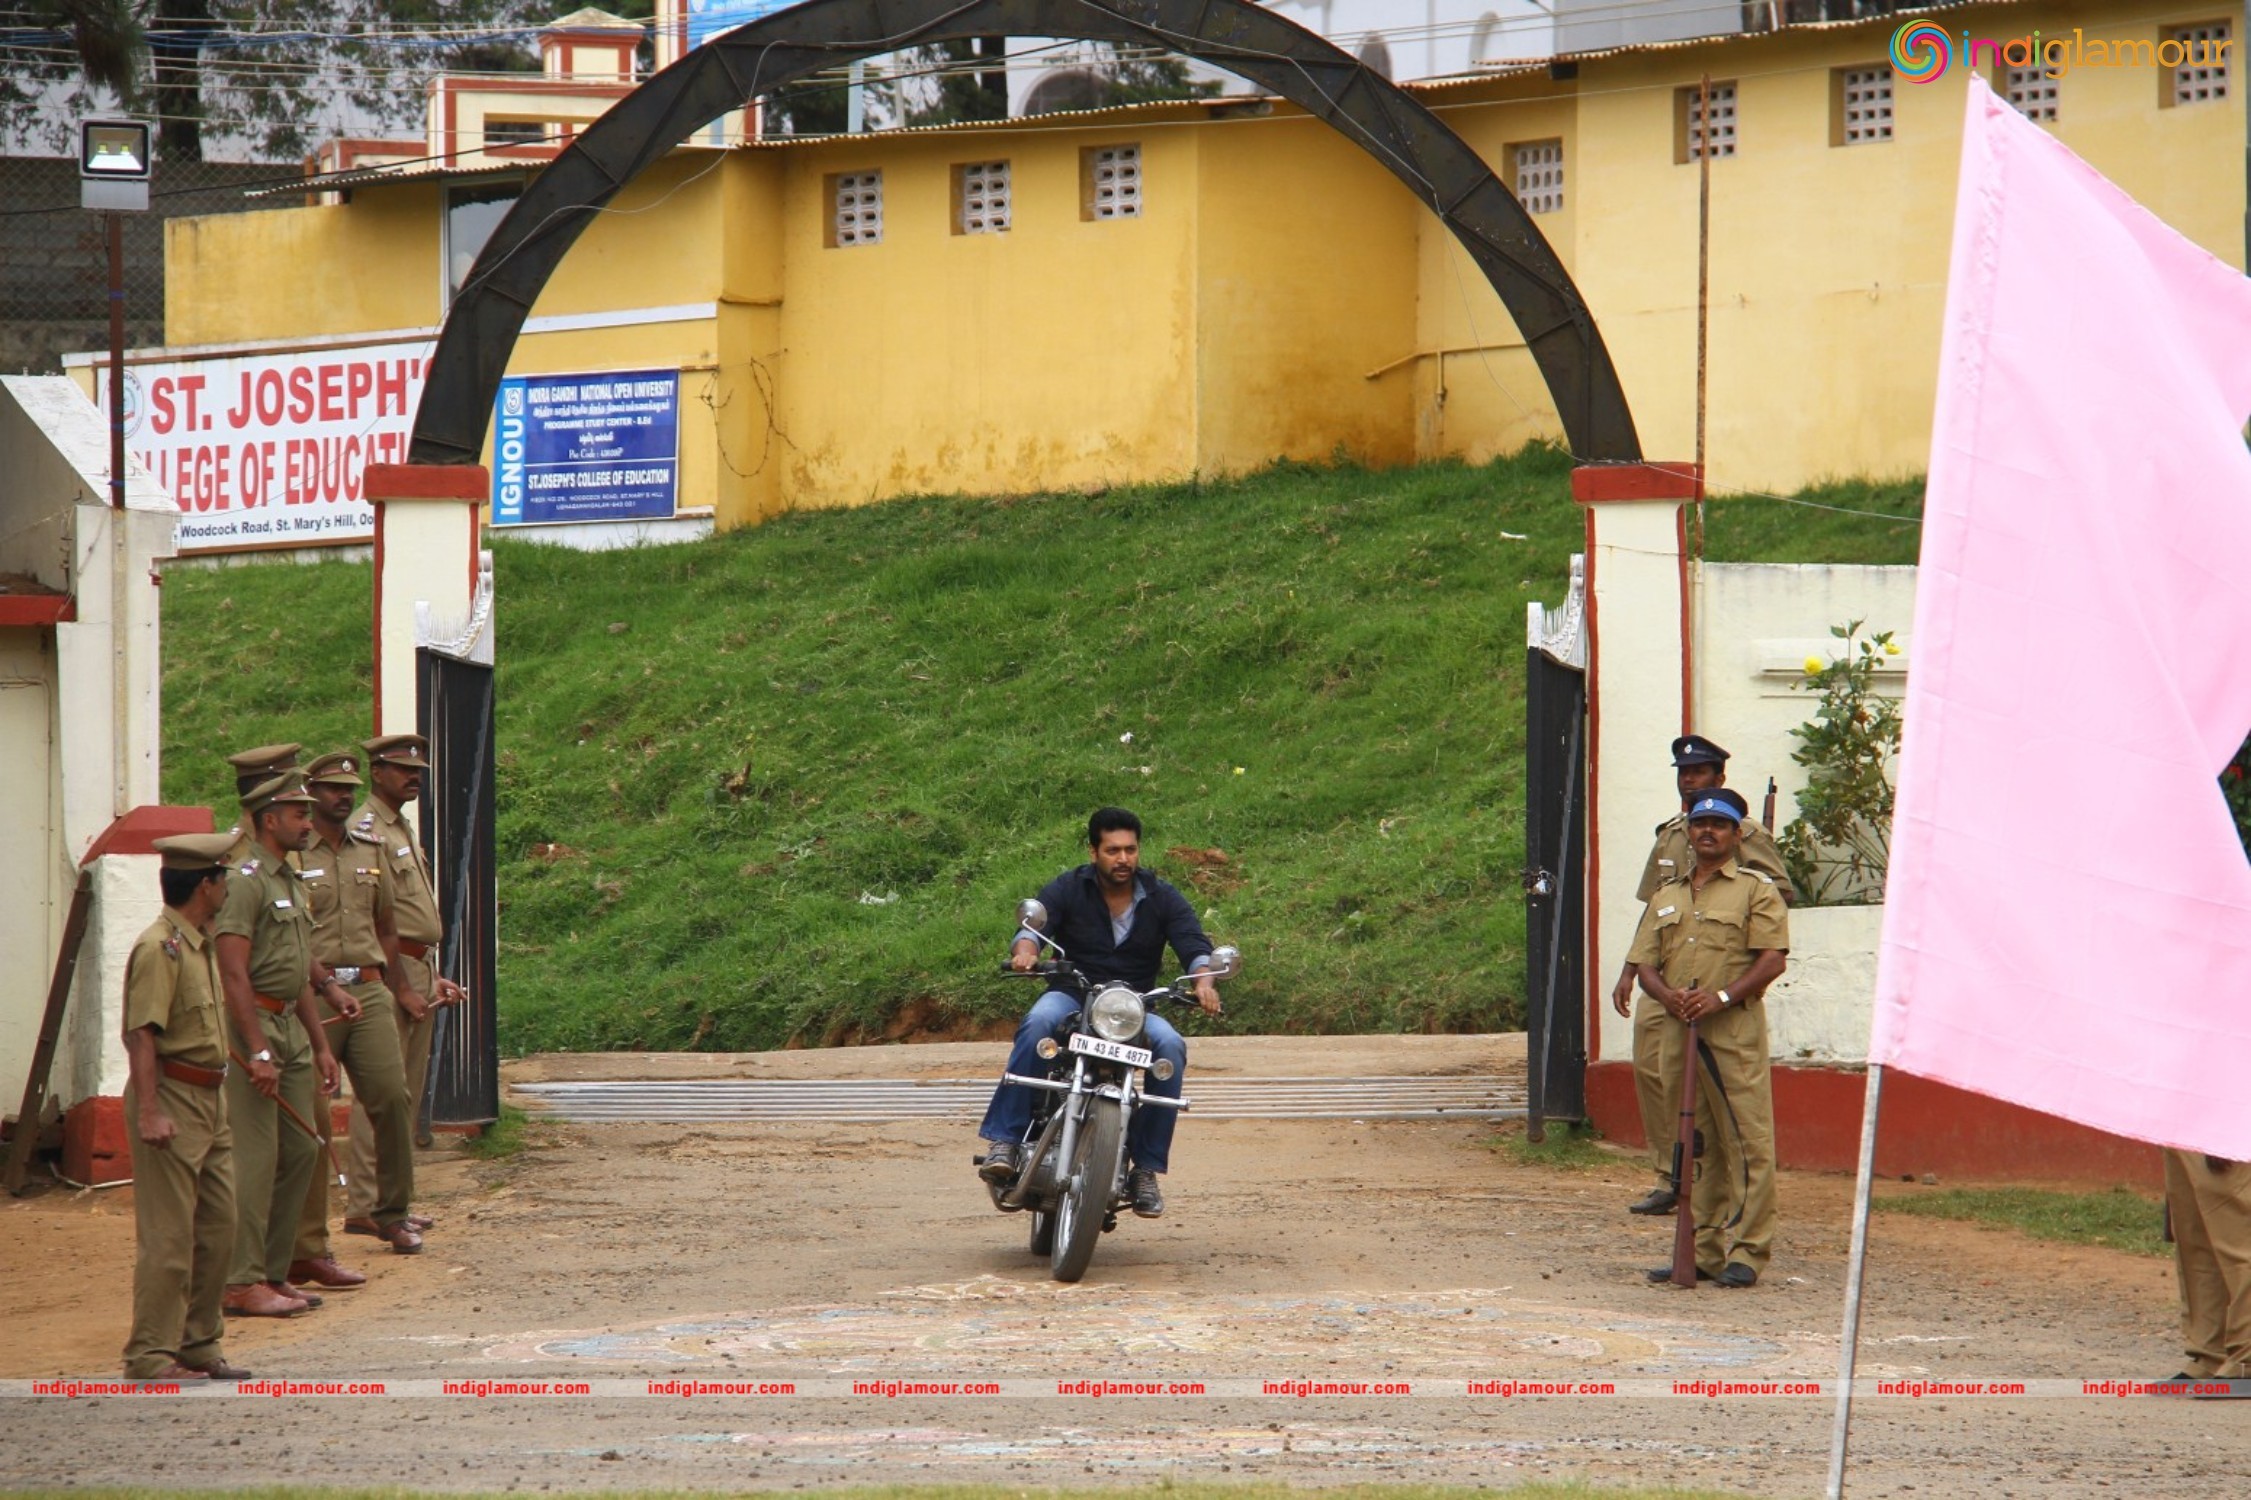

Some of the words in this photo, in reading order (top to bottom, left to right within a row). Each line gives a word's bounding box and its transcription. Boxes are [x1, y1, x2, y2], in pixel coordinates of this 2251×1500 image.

[151, 374, 212, 434] ST.
[228, 357, 434, 429] JOSEPH'
[551, 385, 578, 403] GANDHI
[580, 383, 613, 401] NATIONAL
[613, 382, 633, 399] OPEN
[634, 380, 674, 398] UNIVERSITY
[585, 418, 605, 428] STUDY
[240, 441, 276, 508] OF
[500, 418, 524, 515] IGNOU
[528, 473, 576, 490] ST.JOSEPH'S
[577, 471, 612, 487] COLLEGE
[612, 470, 624, 486] OF
[624, 468, 669, 485] EDUCATION
[181, 523, 238, 538] Woodcock
[242, 520, 273, 535] Road,
[276, 518, 290, 531] St.
[295, 516, 331, 532] Mary's
[334, 514, 356, 528] Hill,
[360, 513, 374, 526] Oo
[1076, 1037, 1089, 1051] TN
[1094, 1042, 1106, 1055] 43
[1107, 1045, 1121, 1058] AE
[1125, 1049, 1149, 1064] 4877
